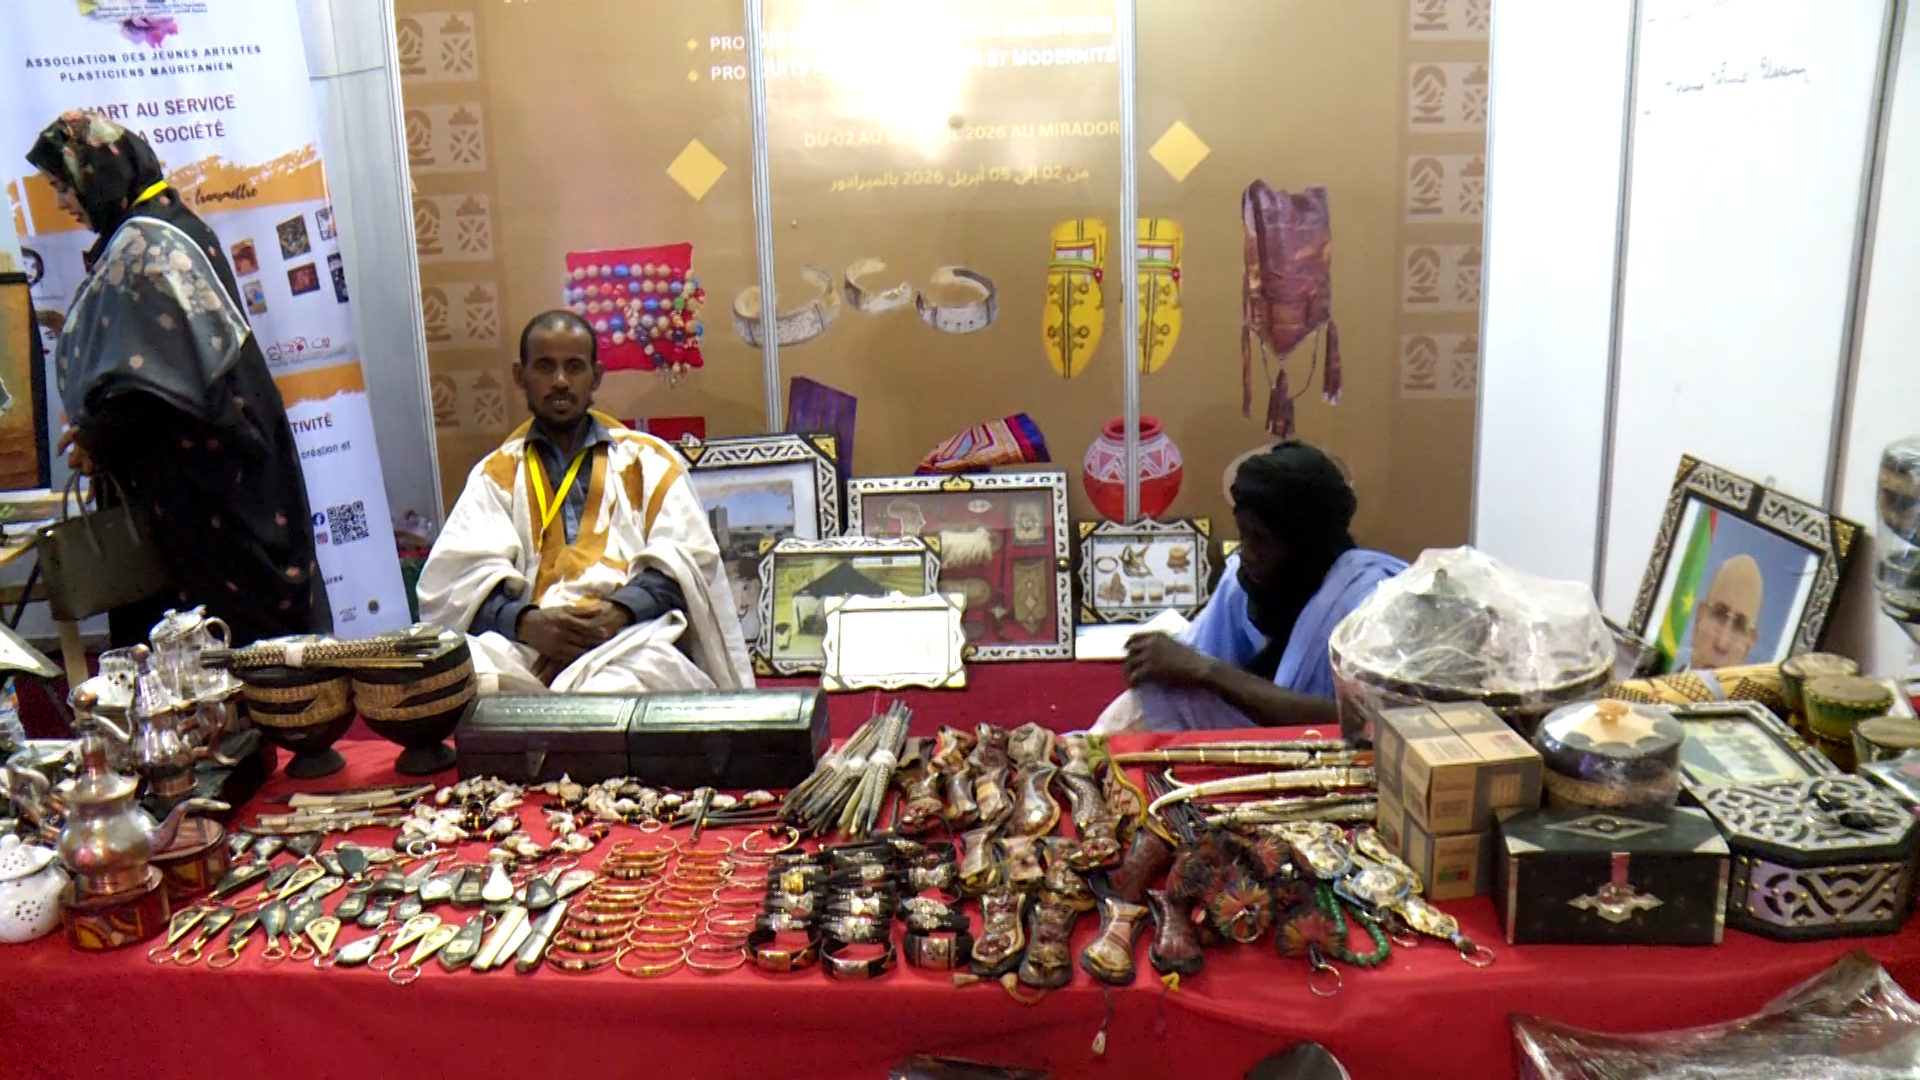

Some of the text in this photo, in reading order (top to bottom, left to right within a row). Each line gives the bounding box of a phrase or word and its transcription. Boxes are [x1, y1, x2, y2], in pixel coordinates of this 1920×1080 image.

[25, 44, 262, 69] ASSOCIATION DES JEUNES ARTISTES
[987, 49, 1008, 67] ET
[1012, 44, 1117, 65] MODERNITÉ
[60, 61, 234, 83] PLASTICIENS MAURITANIEN
[136, 101, 159, 118] AU
[164, 94, 236, 116] SERVICE
[153, 119, 225, 144] SOCIÉTÉ
[804, 131, 831, 147] DU
[859, 130, 882, 145] AU
[965, 124, 1008, 140] 2026
[1012, 123, 1035, 139] AU
[1039, 120, 1120, 137] MIRADOR
[902, 169, 944, 185] 2026
[946, 166, 985, 187] أبريل
[1014, 167, 1039, 185] إلى
[1042, 166, 1062, 180] 02
[1065, 167, 1091, 184] من
